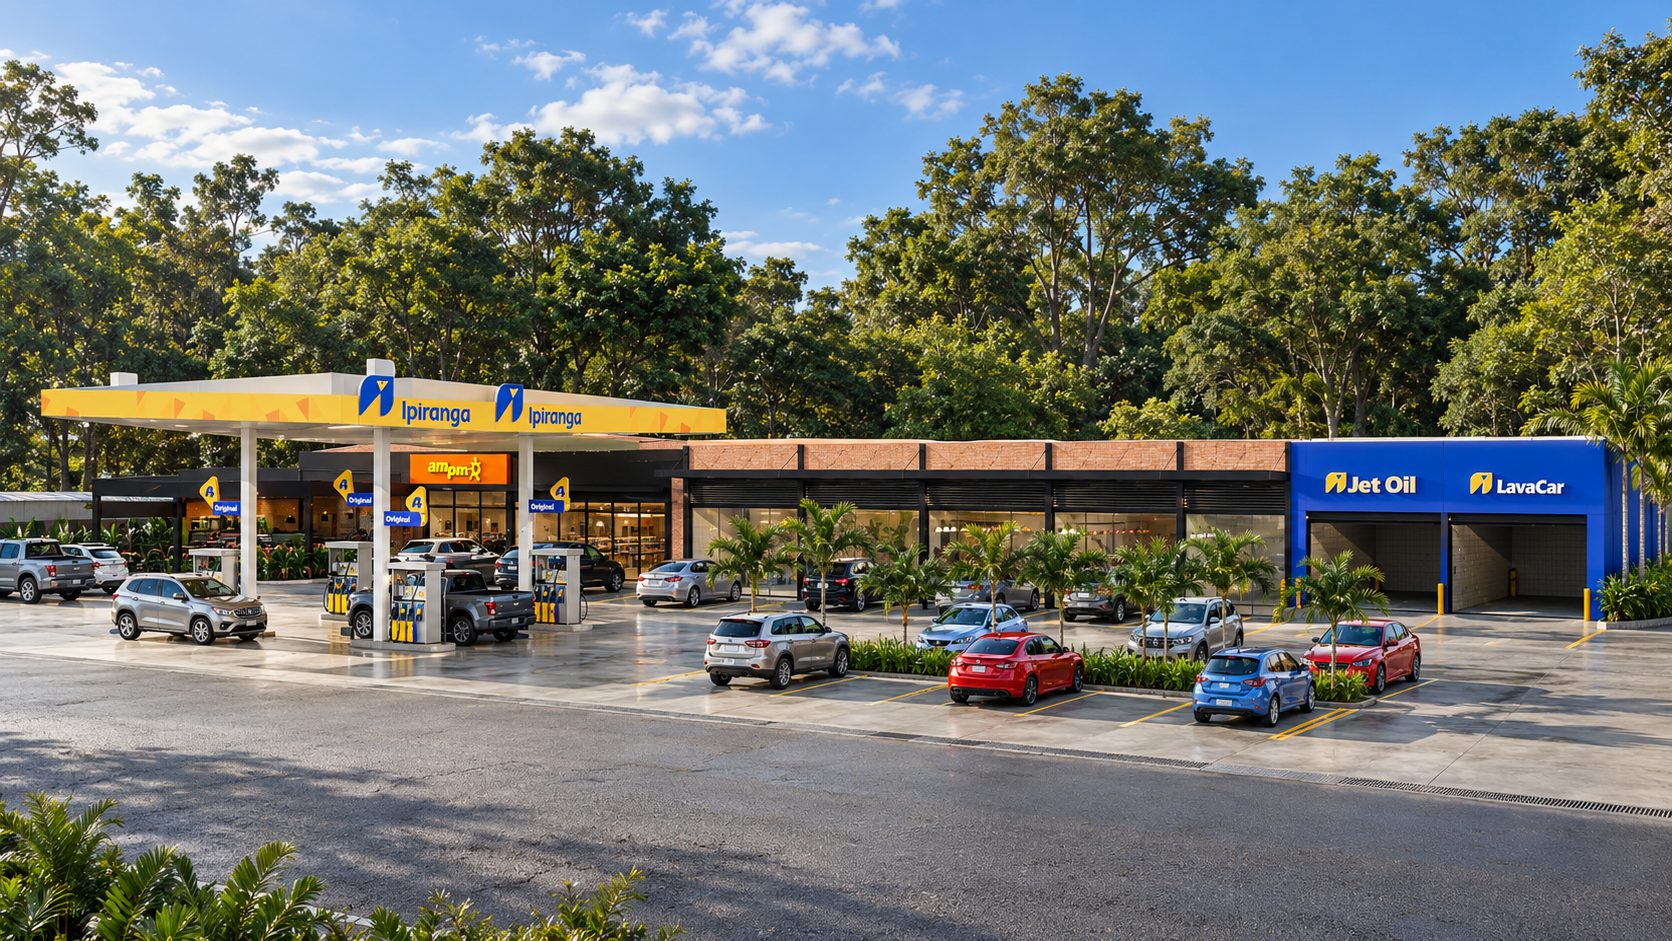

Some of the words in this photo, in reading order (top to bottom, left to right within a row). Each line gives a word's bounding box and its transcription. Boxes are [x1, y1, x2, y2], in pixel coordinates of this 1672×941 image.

[402, 400, 470, 427] Ipiranga
[529, 406, 582, 429] Ipiranga
[428, 460, 468, 480] ampm
[1347, 476, 1381, 494] Jet
[1385, 476, 1416, 494] Oil
[1497, 479, 1565, 494] LavaCar
[385, 515, 411, 524] Original
